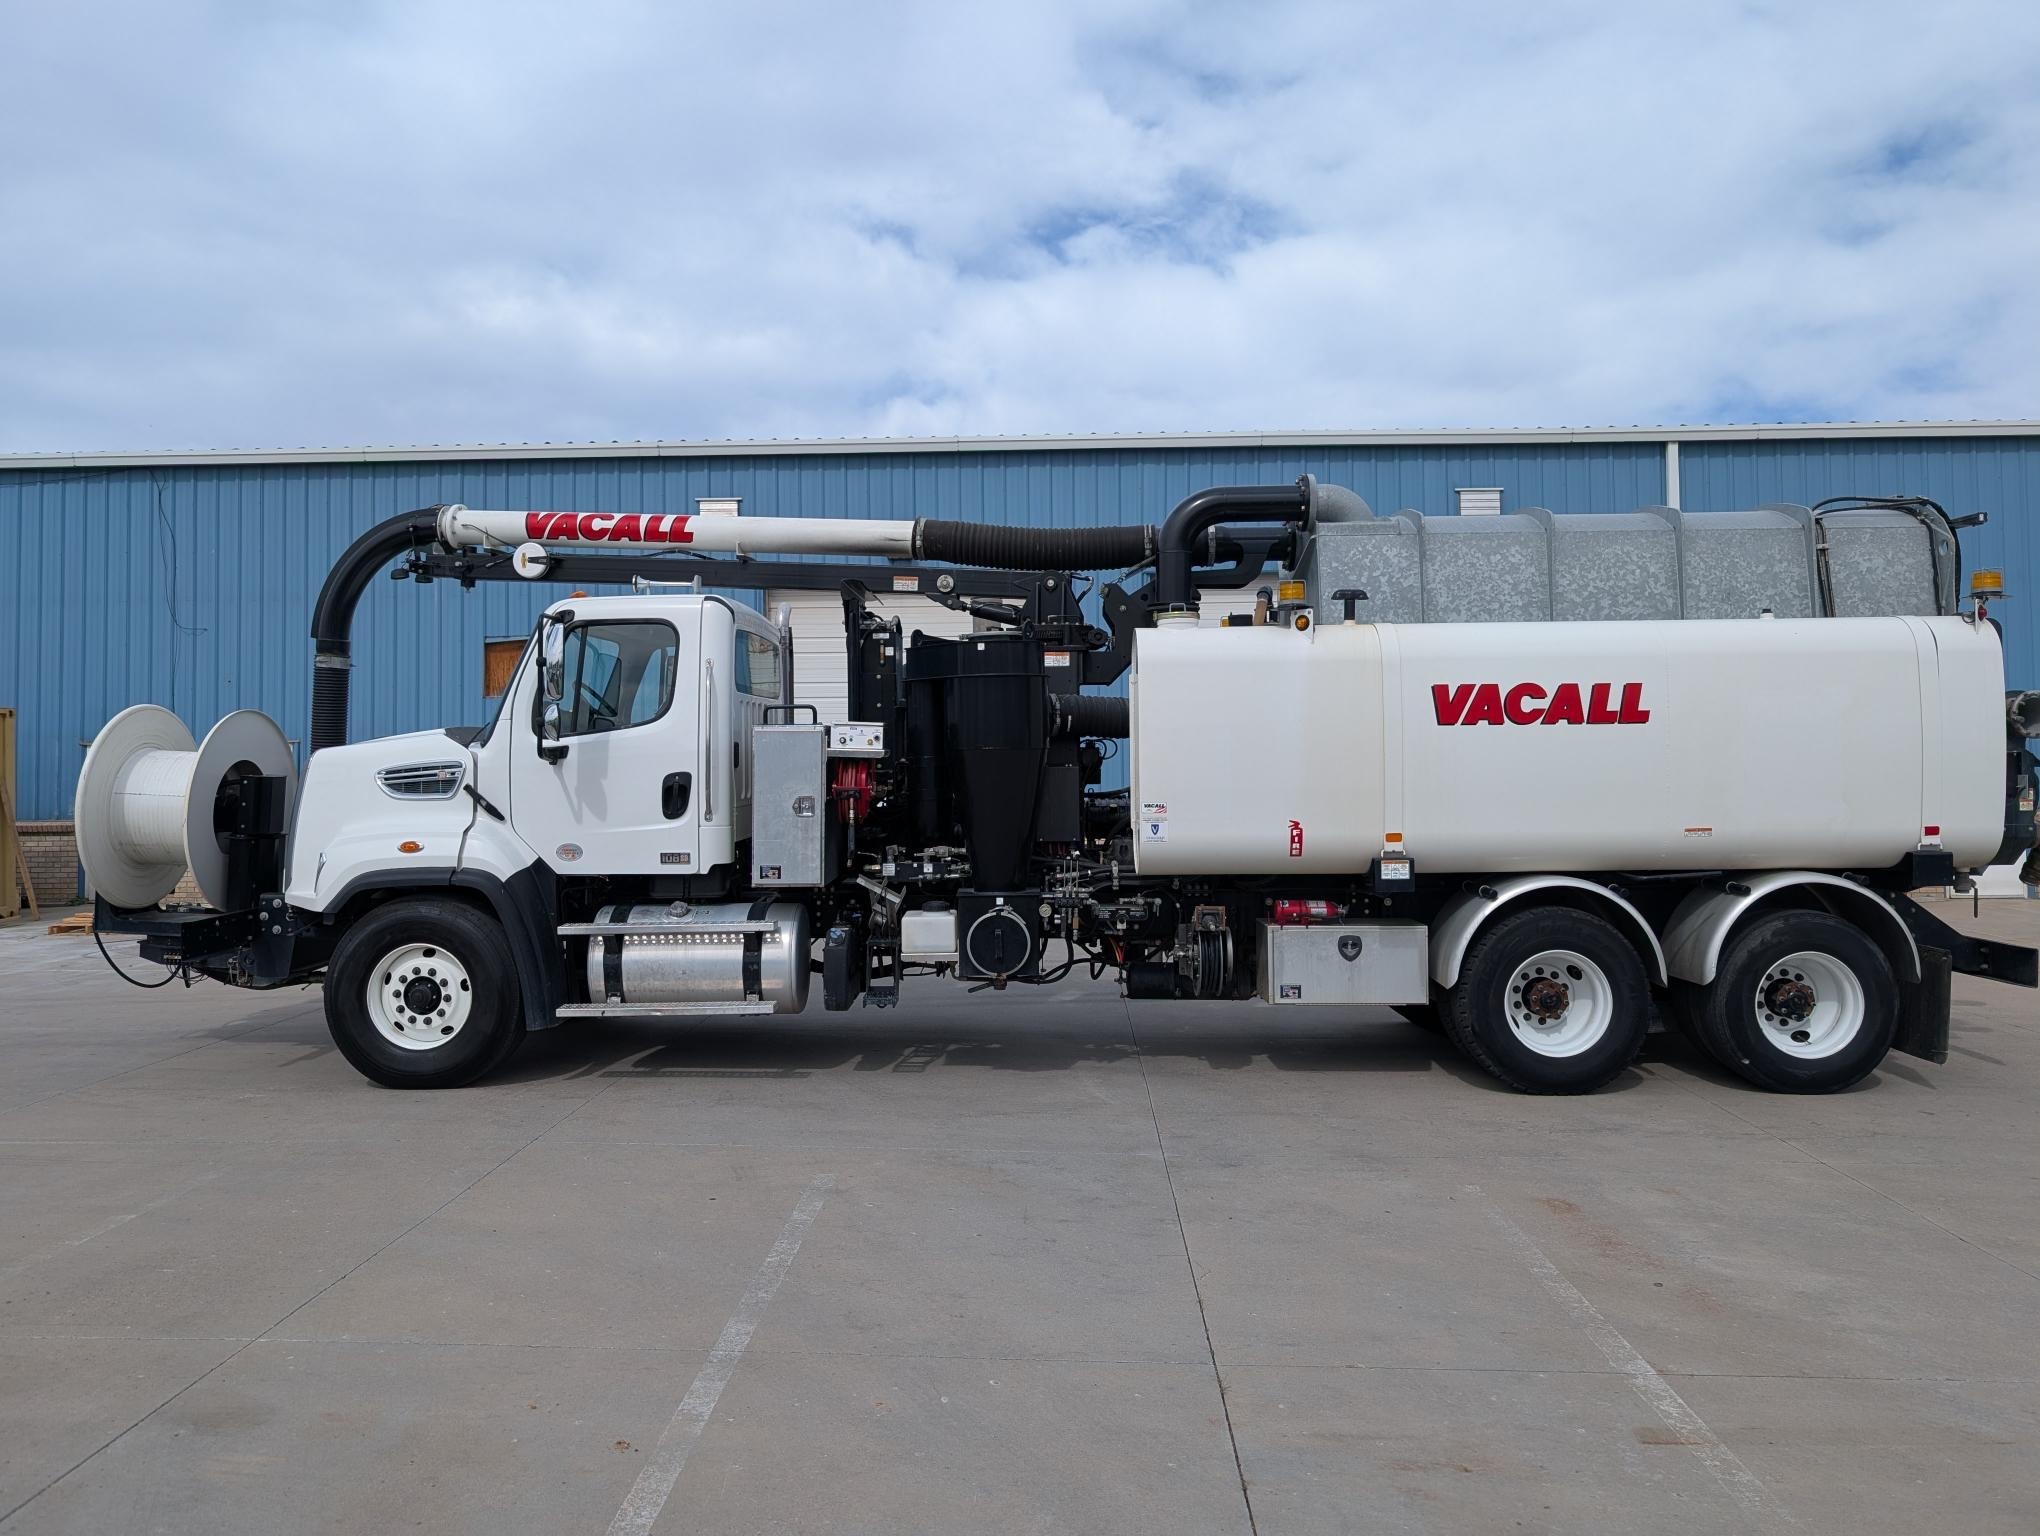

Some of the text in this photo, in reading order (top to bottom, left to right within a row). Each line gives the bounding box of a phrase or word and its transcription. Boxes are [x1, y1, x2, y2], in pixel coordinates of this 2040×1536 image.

[525, 511, 694, 543] VACALL
[1431, 682, 1650, 726] VACALL
[1292, 829, 1301, 855] FIRE
